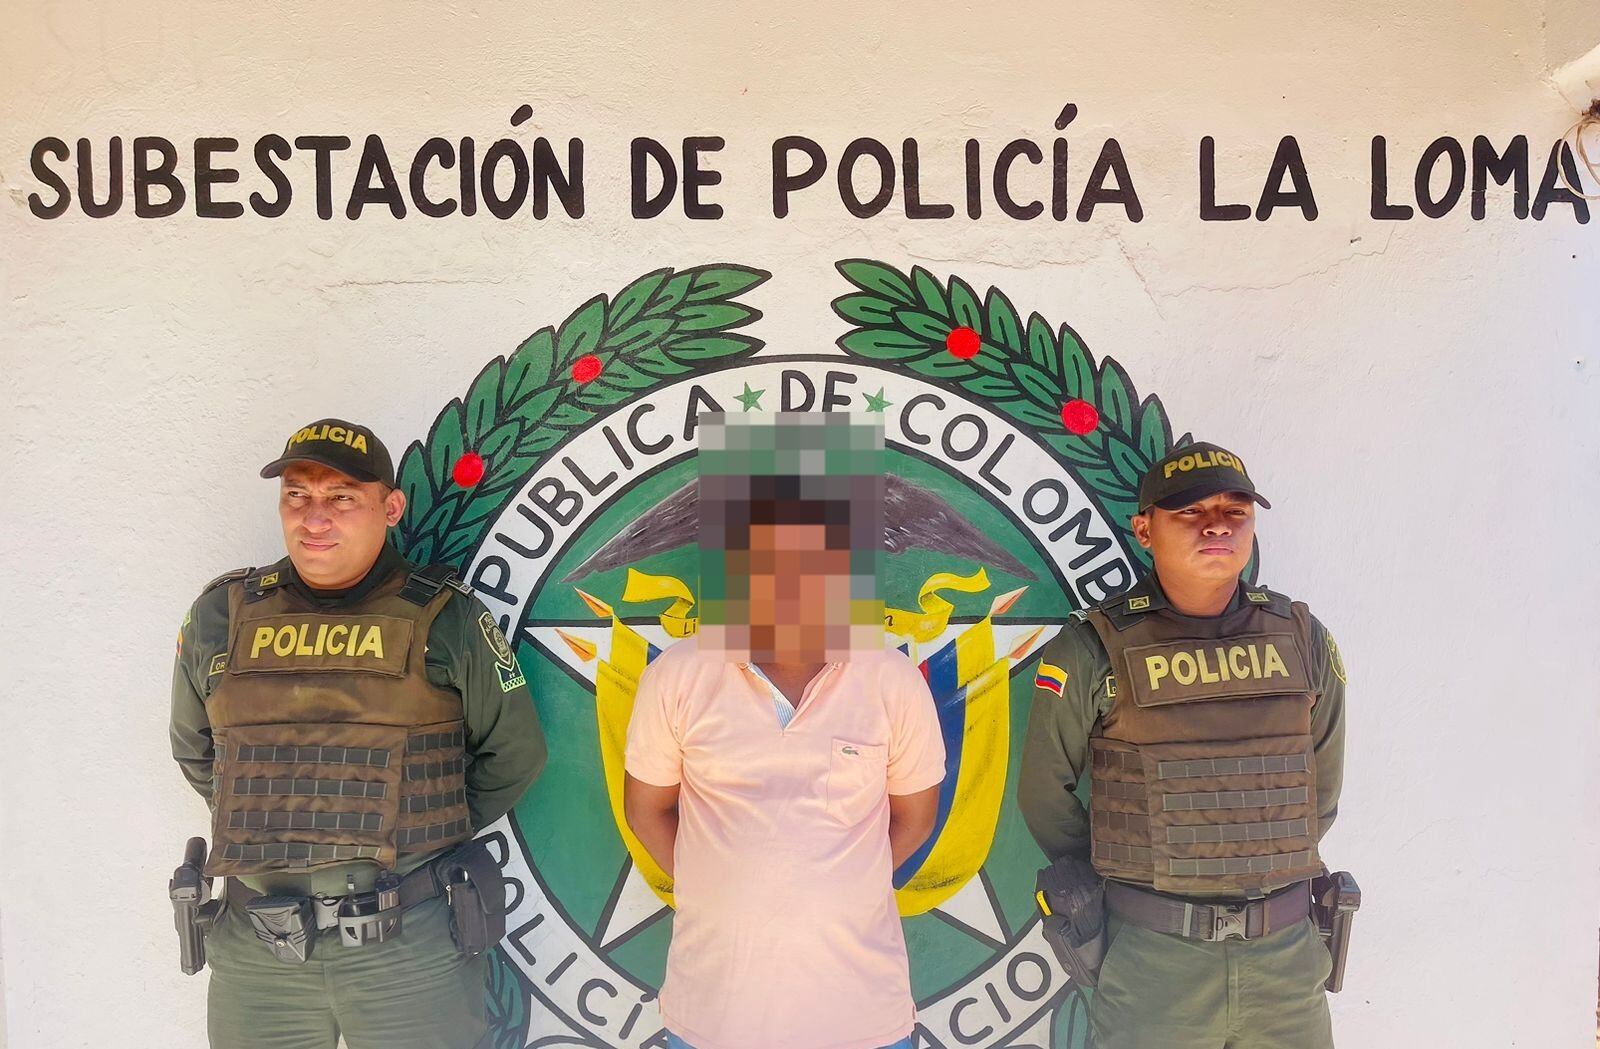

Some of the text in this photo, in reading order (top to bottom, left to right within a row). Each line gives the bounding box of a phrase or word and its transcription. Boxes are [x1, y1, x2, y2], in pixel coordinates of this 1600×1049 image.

[28, 102, 1591, 225] SUBESTACIÓN DE POLICÍA LA LOMA
[288, 424, 367, 454] POLICIA
[1164, 450, 1245, 478] POLICIA
[250, 623, 384, 659] POLICIA
[1145, 643, 1289, 690] POLICIA
